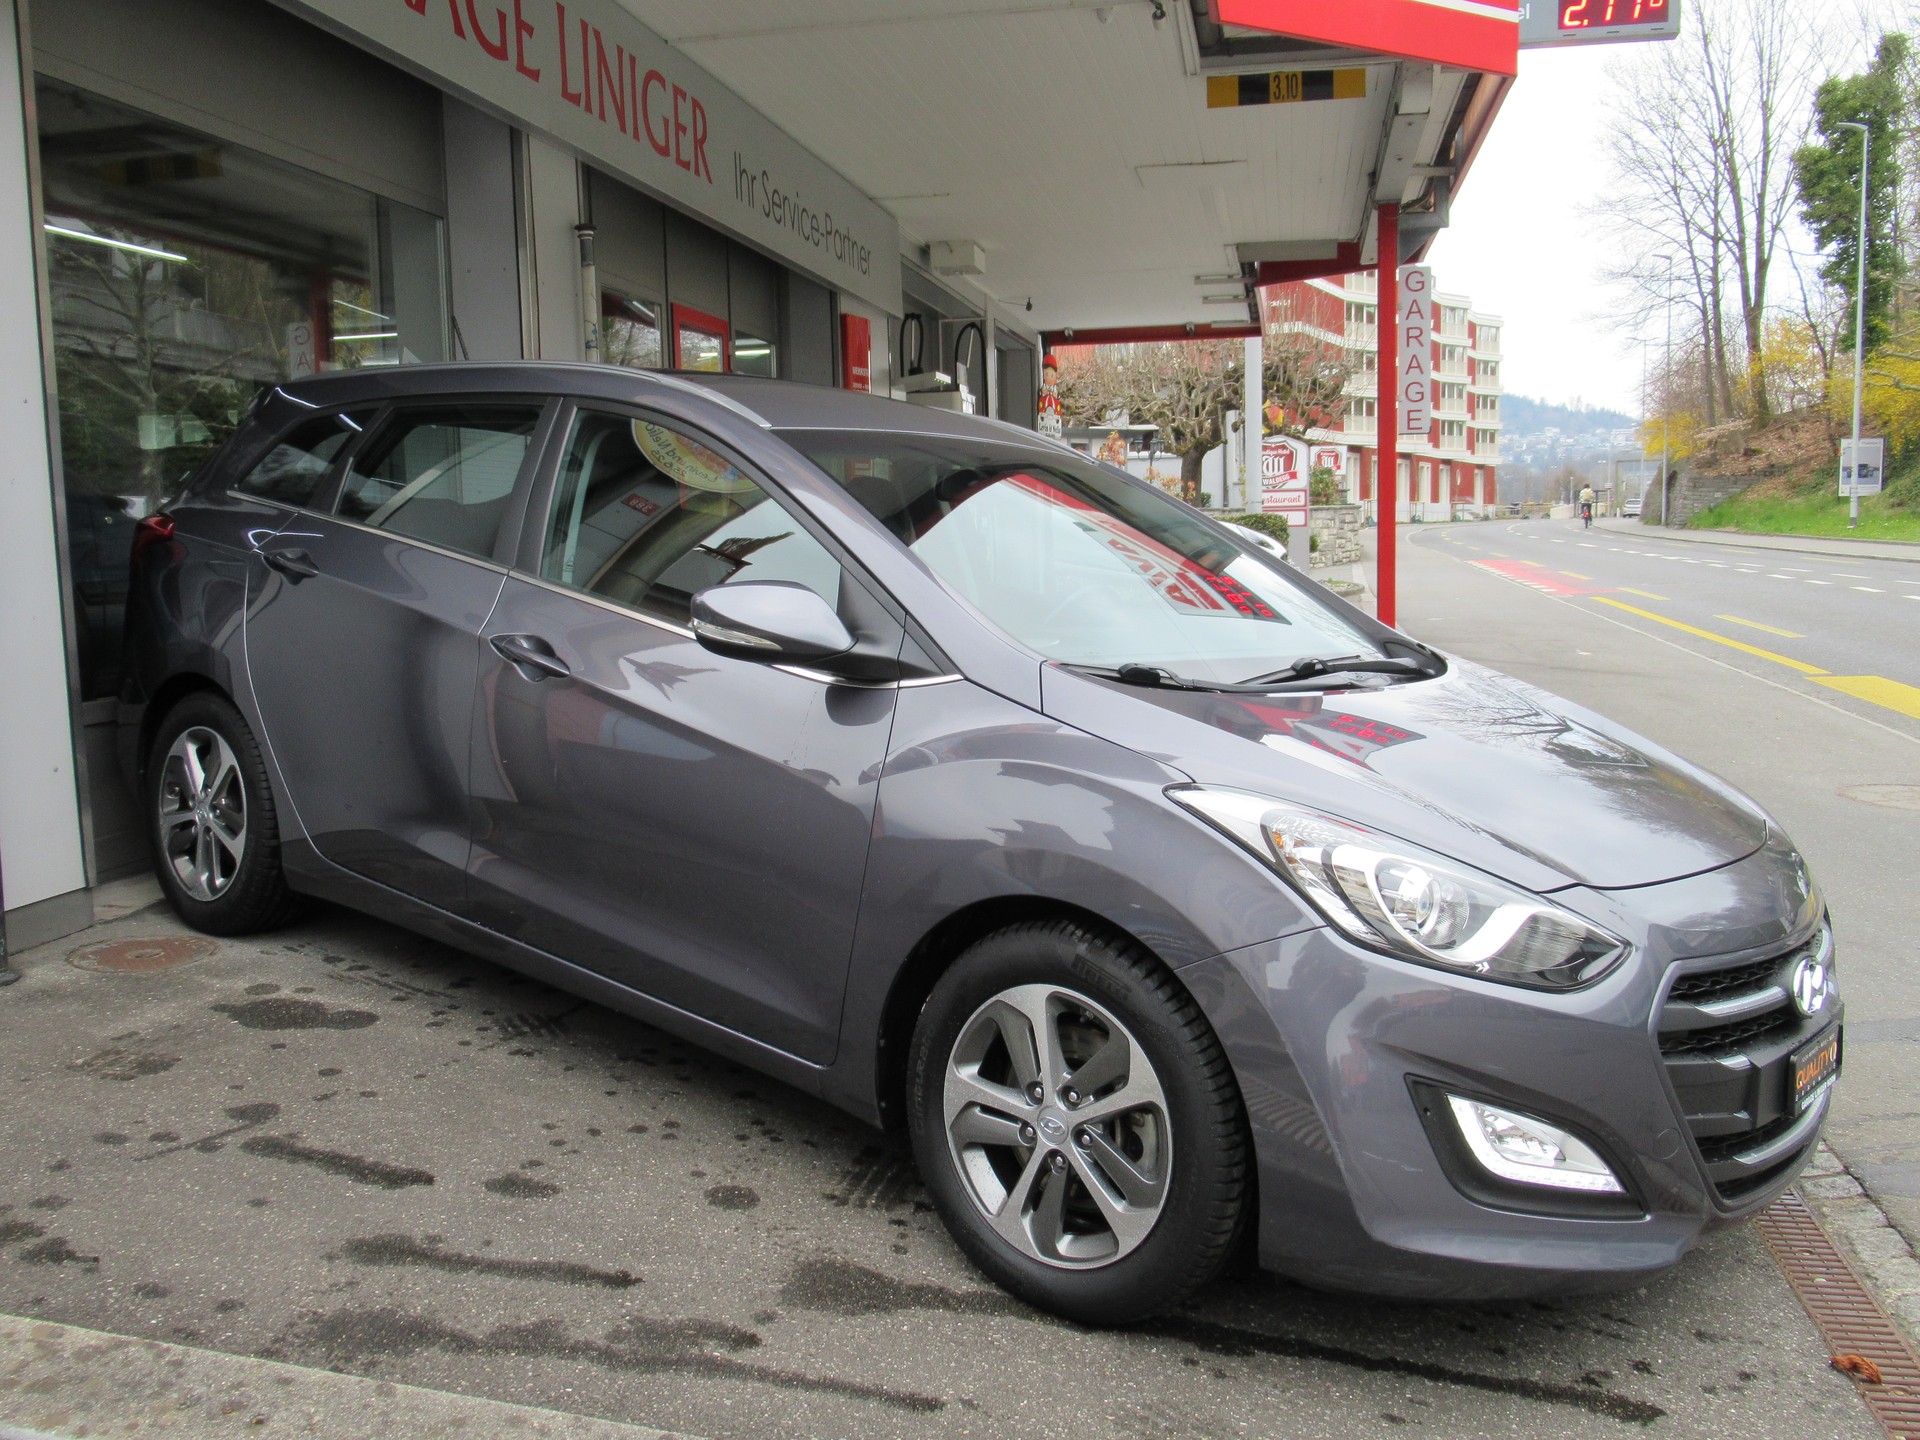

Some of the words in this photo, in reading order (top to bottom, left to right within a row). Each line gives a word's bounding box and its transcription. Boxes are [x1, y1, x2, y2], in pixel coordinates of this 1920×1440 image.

[556, 1, 713, 185] LINIGER
[733, 151, 757, 209] Ihr
[761, 170, 871, 278] Service-Partner
[1404, 270, 1425, 431] GARAGE
